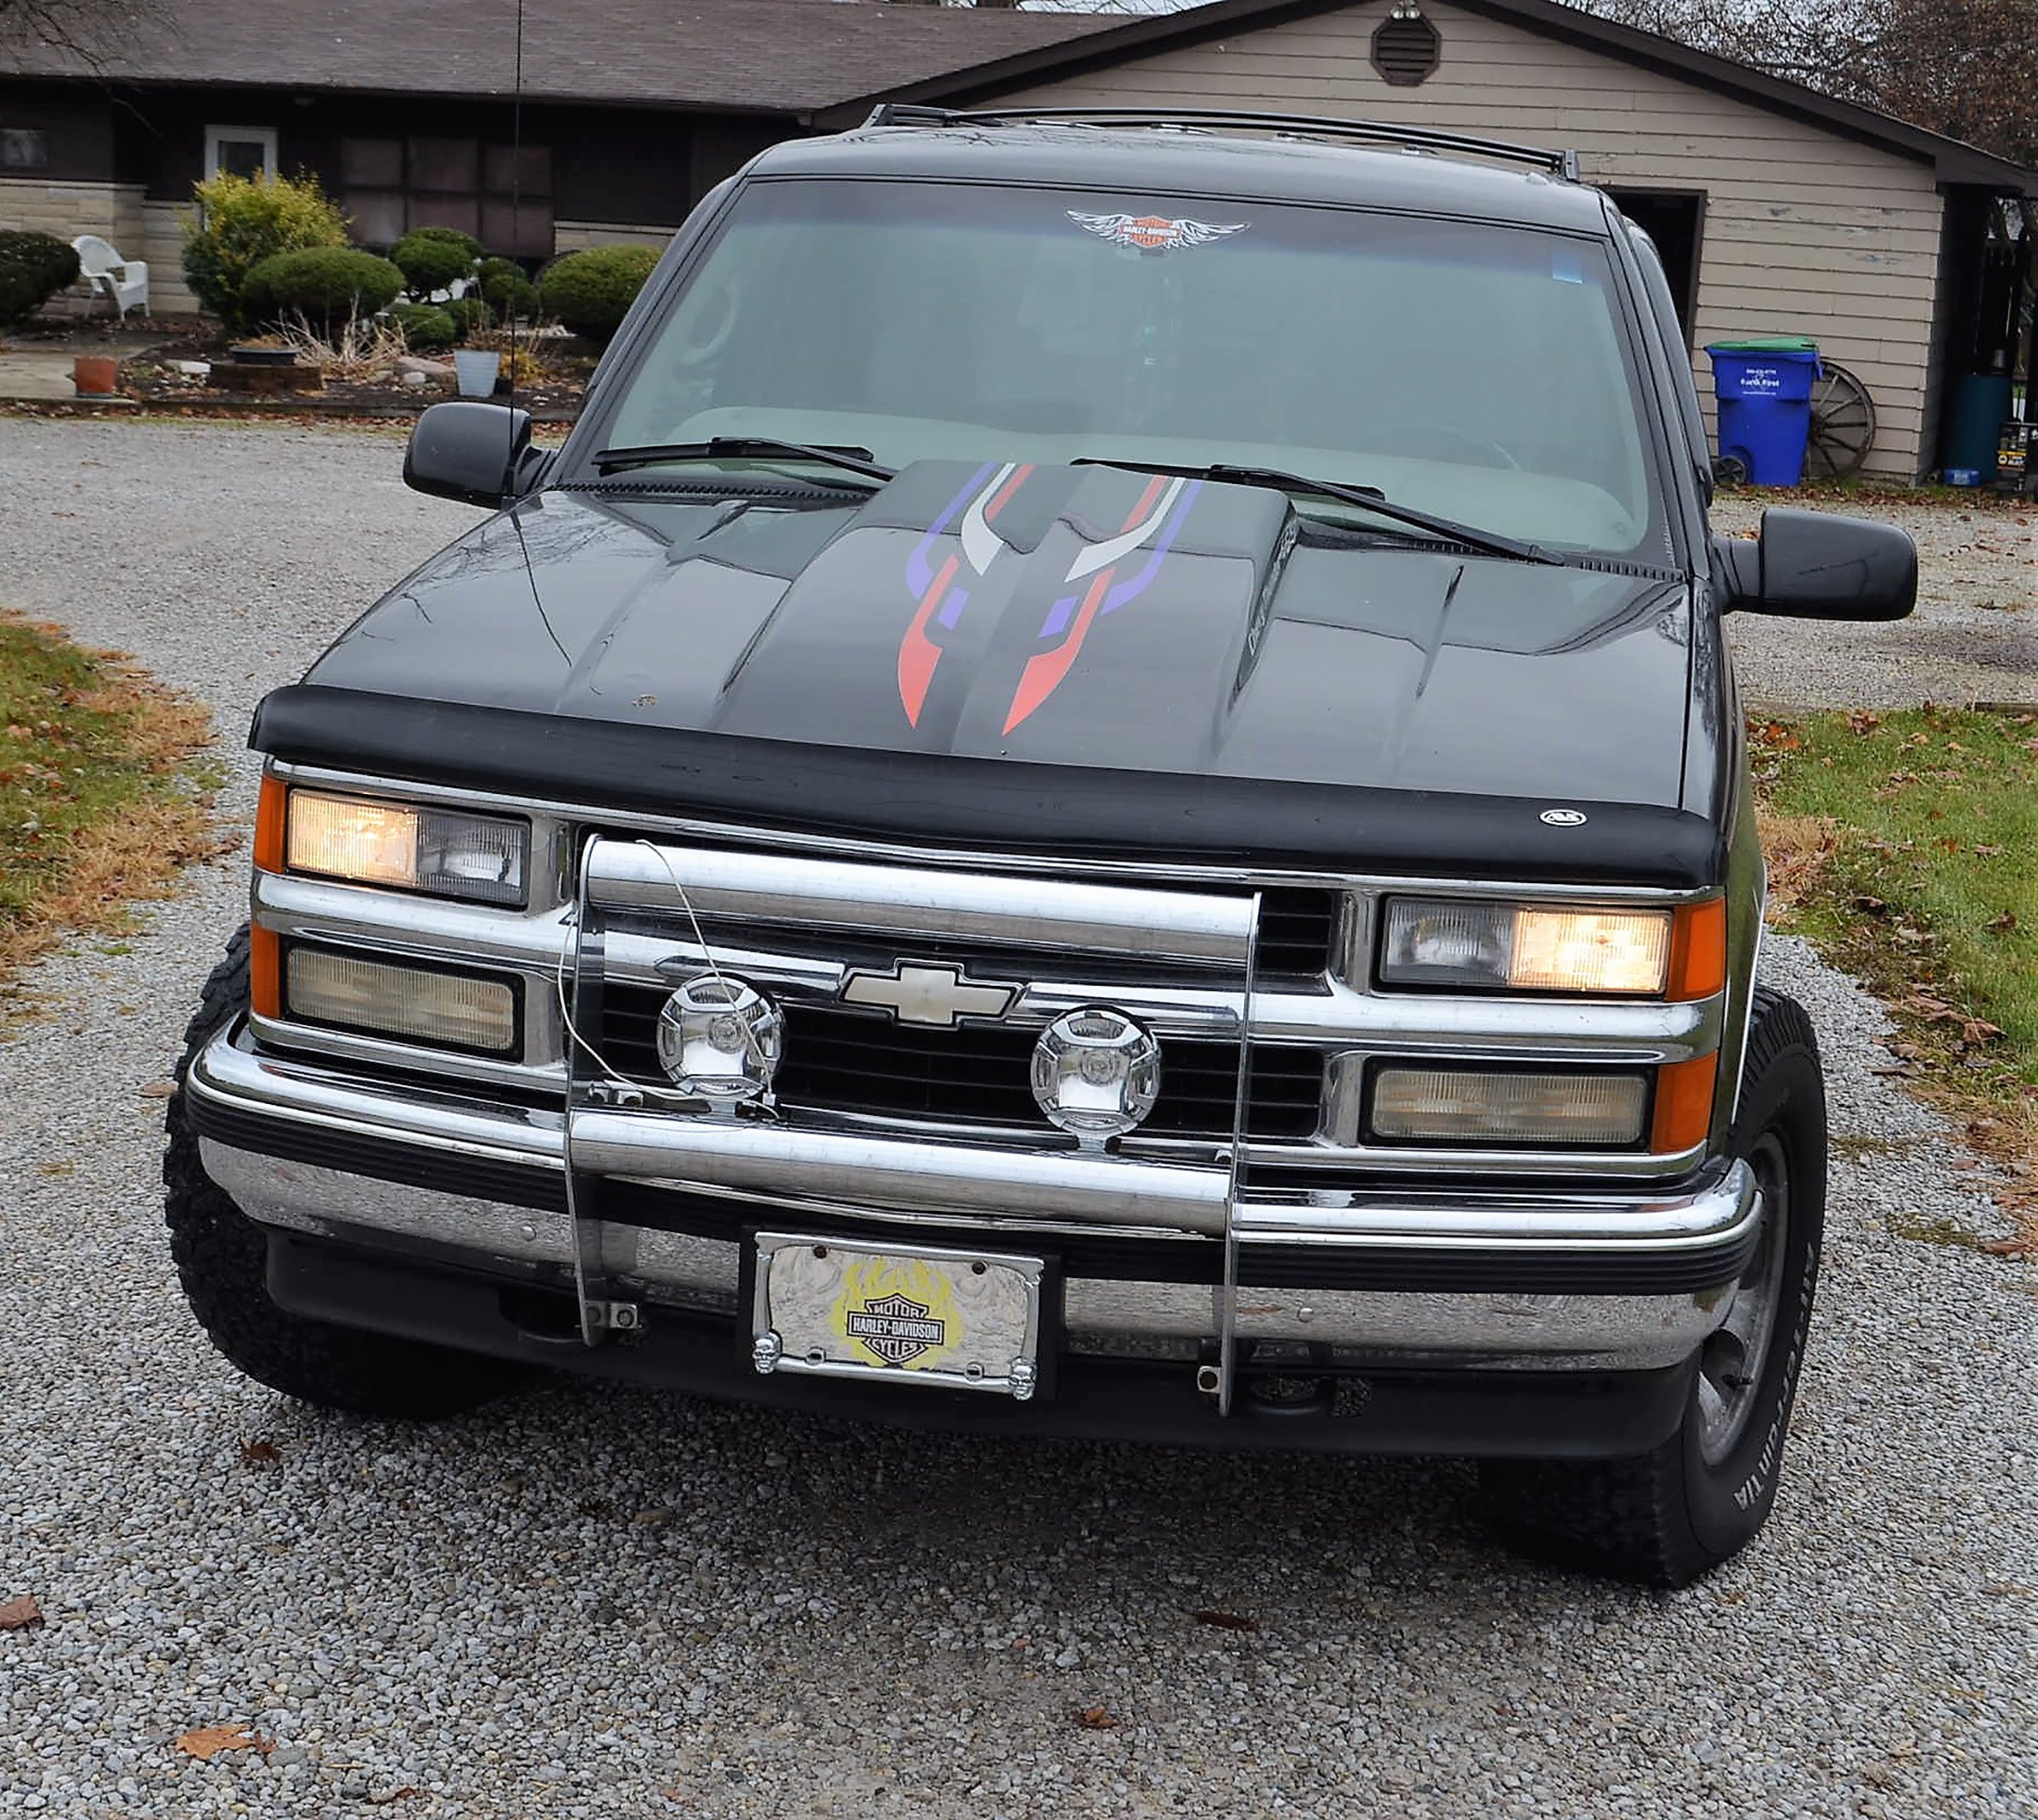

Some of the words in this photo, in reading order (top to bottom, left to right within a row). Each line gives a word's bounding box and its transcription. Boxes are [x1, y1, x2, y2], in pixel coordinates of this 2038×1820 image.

[873, 1299, 920, 1318] MOTOR
[853, 1317, 939, 1339] HARLEY-DAVIDSON
[871, 1338, 918, 1359] CYCLES
